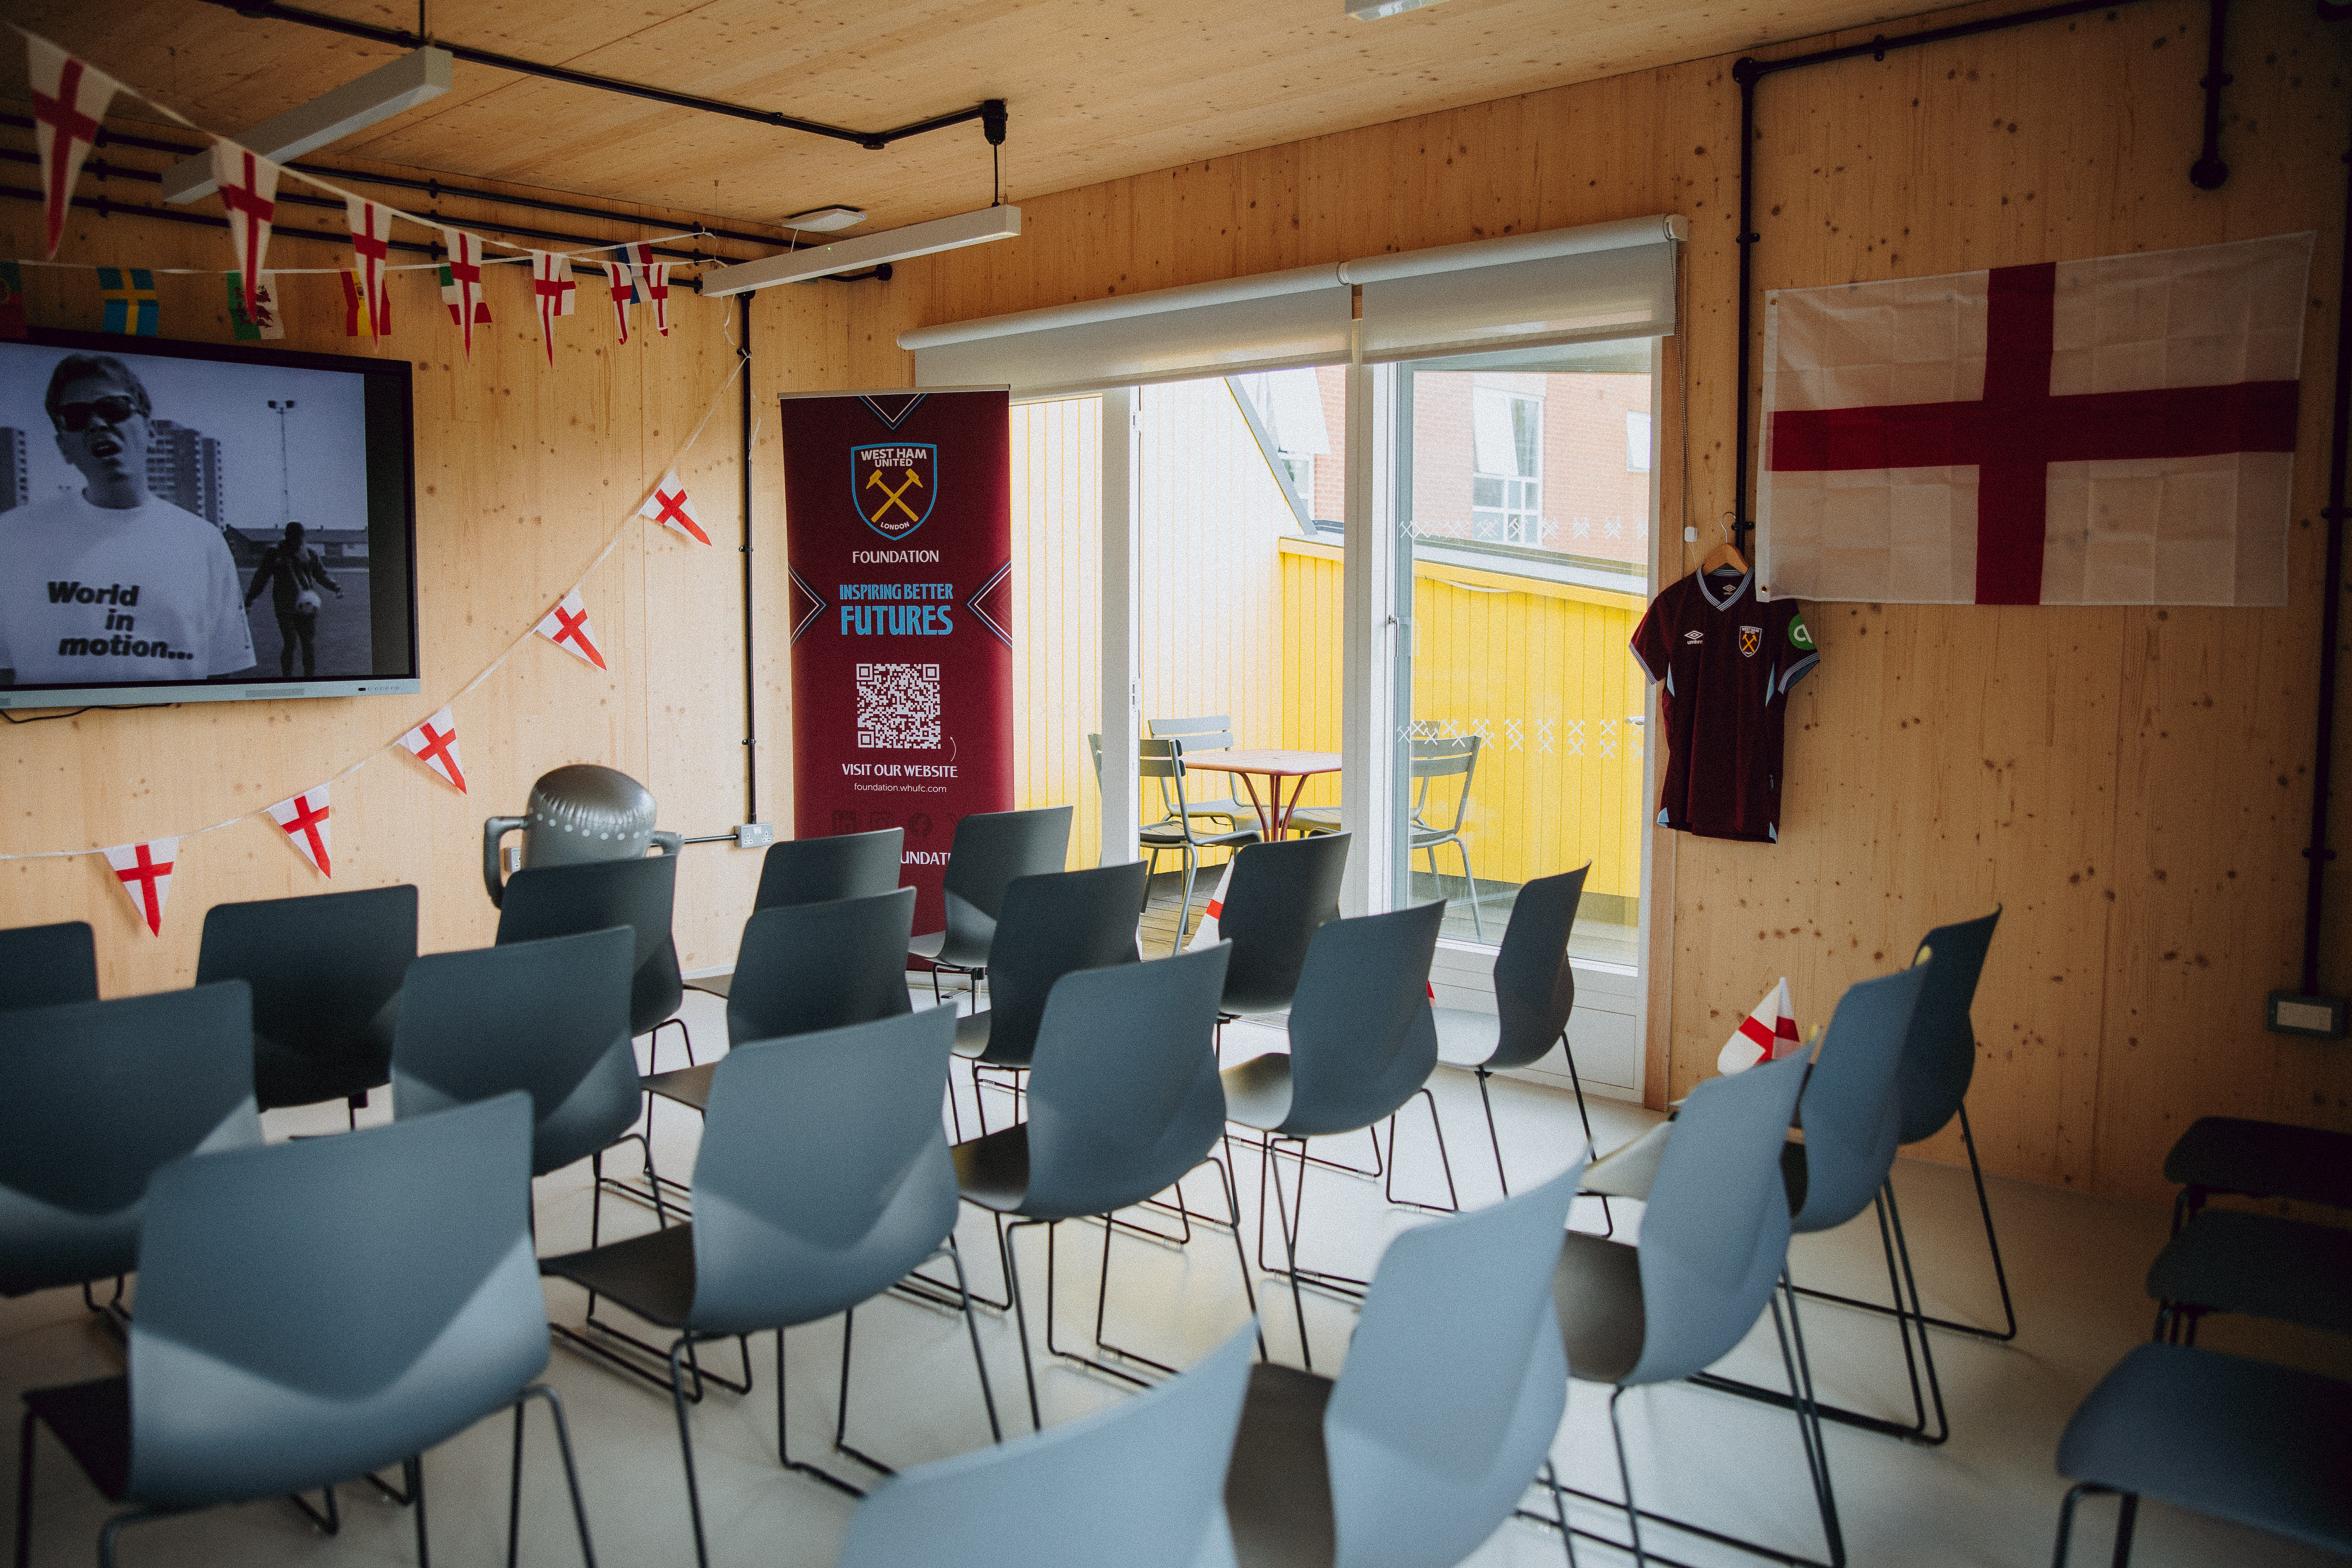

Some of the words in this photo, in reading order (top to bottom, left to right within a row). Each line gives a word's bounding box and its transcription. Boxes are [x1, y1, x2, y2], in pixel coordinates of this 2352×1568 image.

[861, 449, 894, 460] WEST
[897, 448, 927, 459] HAM
[875, 458, 913, 467] UNITED
[880, 521, 910, 530] LONDON
[853, 550, 939, 563] FOUNDATION
[47, 581, 140, 606] World
[840, 584, 901, 600] INSPIRING
[904, 584, 953, 599] BETTER
[105, 608, 135, 631] in
[841, 605, 953, 635] FUTURES
[58, 634, 193, 659] motion...
[842, 763, 872, 775] VISIT
[874, 764, 901, 776] OUR
[904, 765, 958, 778] WEBSITE
[854, 783, 946, 793] foundation.whufc.com
[900, 851, 951, 865] UNDAT
